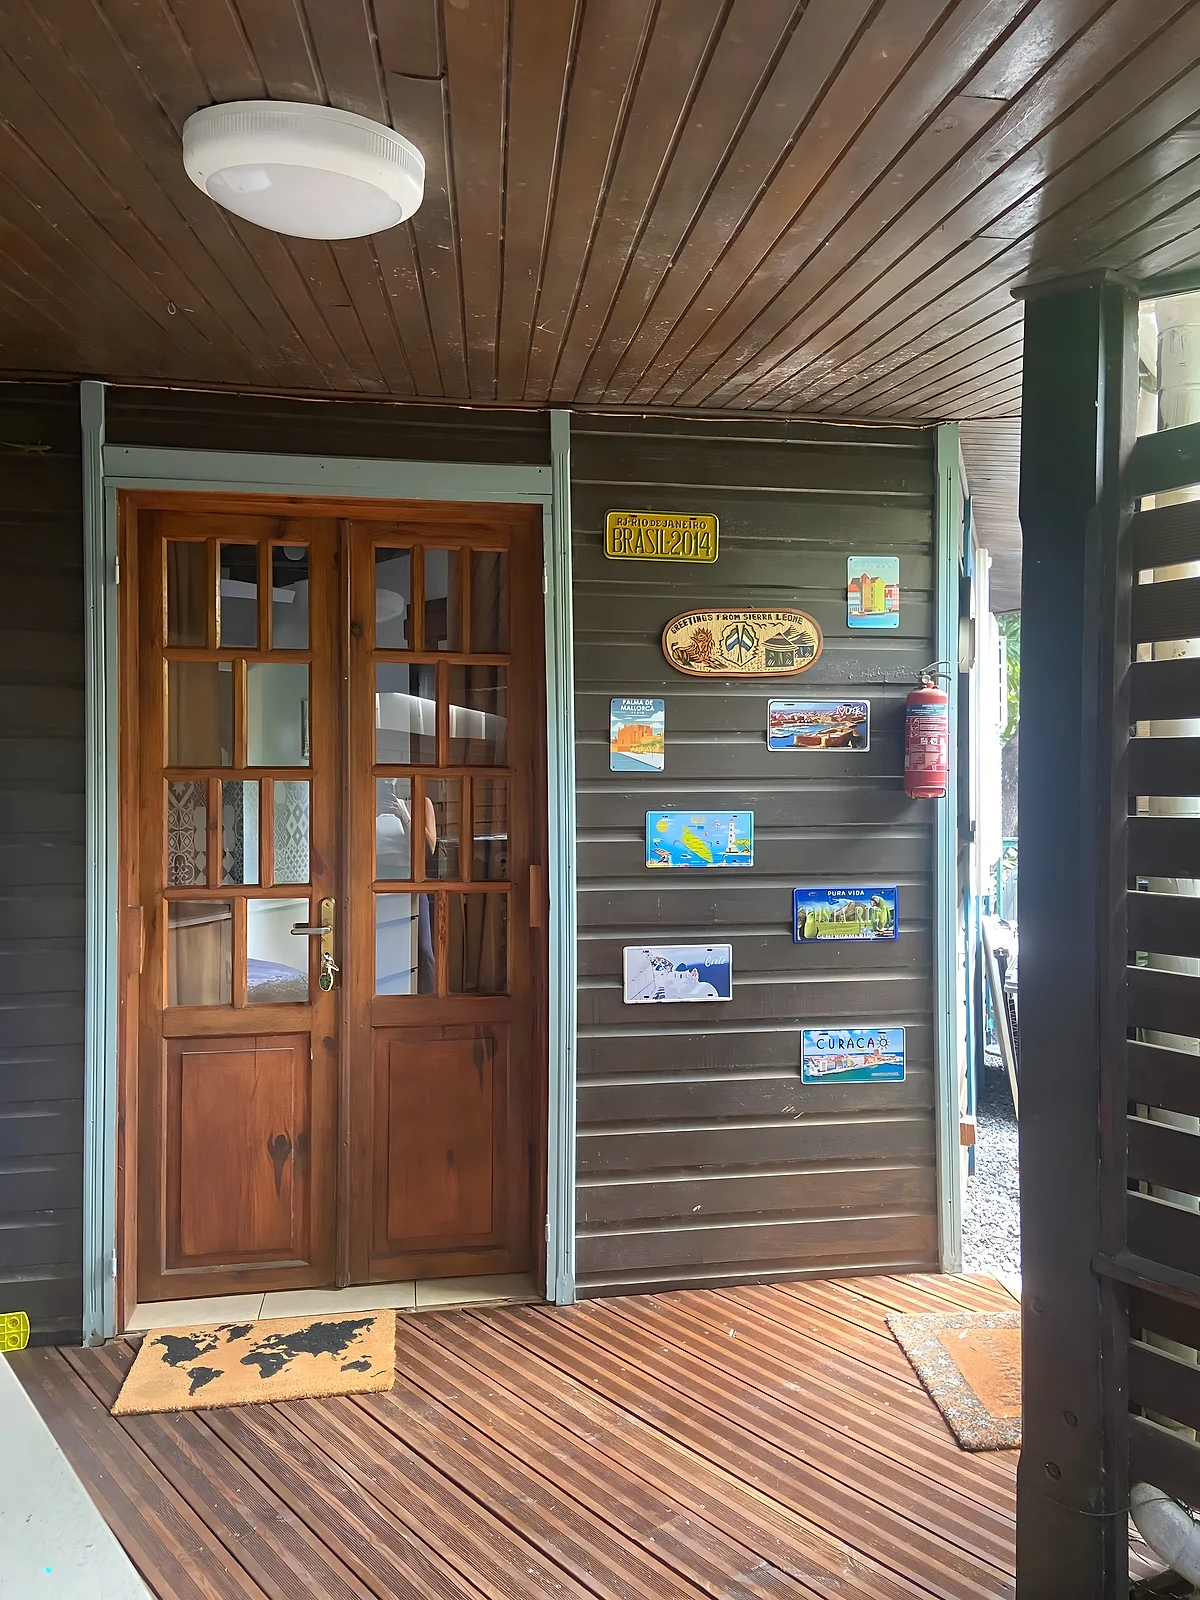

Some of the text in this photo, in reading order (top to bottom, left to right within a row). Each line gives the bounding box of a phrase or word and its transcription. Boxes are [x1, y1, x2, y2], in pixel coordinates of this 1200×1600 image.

[662, 519, 707, 530] JANEIRO
[670, 613, 804, 635] GREETINGS FROM SIERRA LEONE
